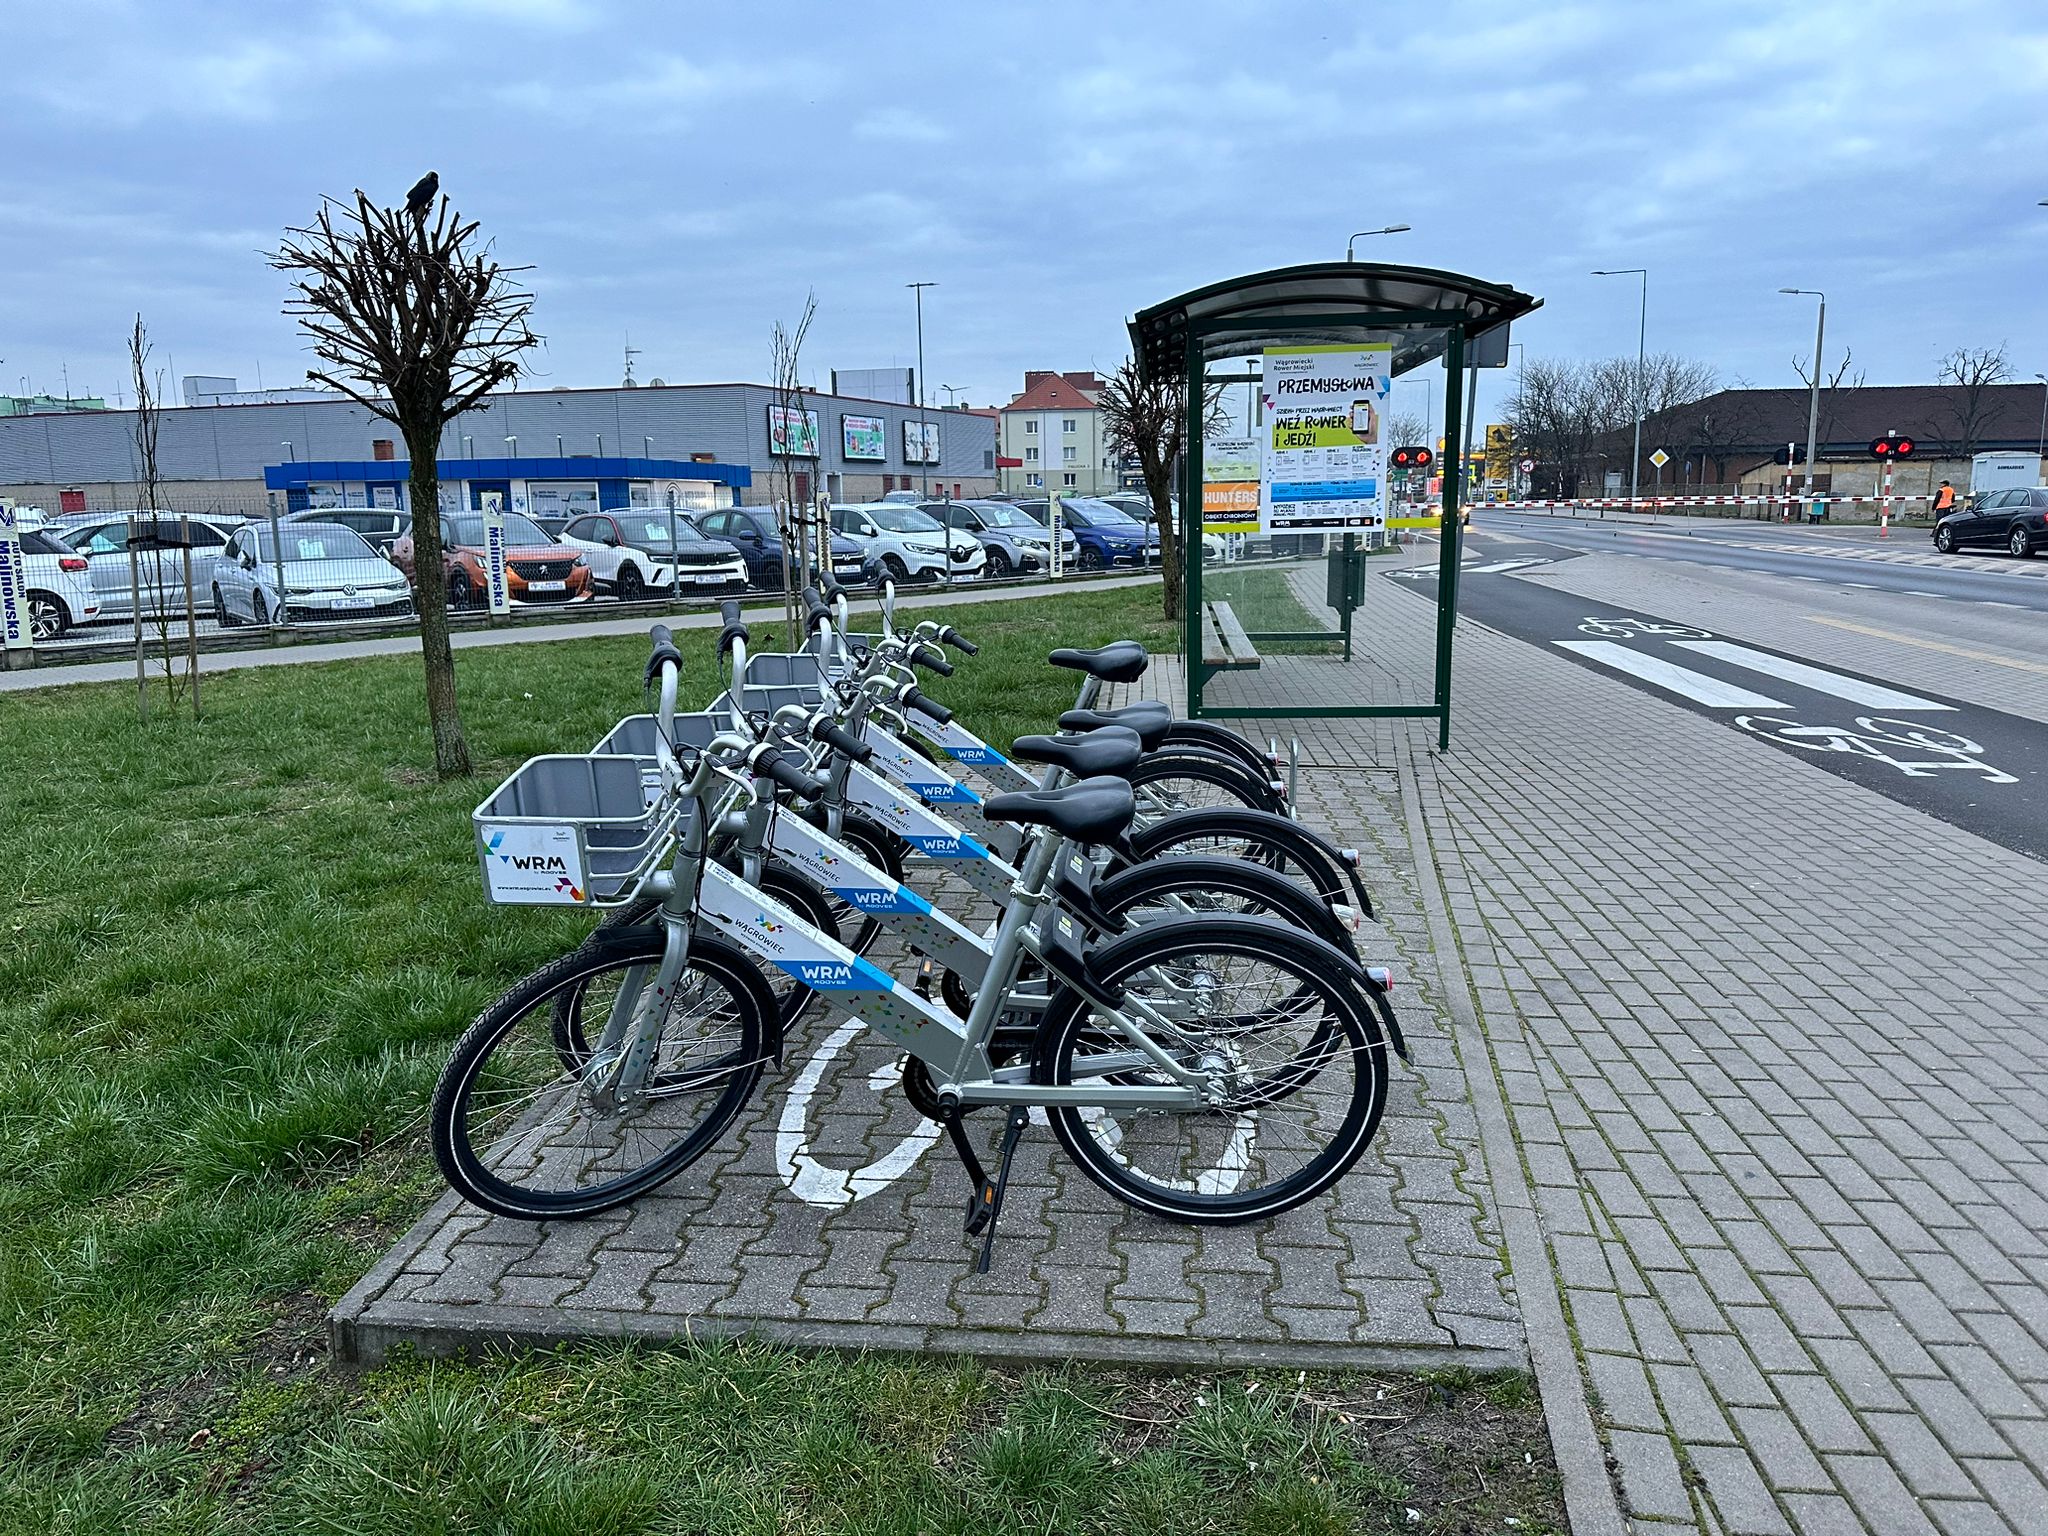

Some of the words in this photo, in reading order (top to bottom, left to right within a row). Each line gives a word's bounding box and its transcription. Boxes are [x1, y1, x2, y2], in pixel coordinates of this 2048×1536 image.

[1275, 357, 1314, 366] Wągrowiecki
[1294, 363, 1314, 371] Miejski
[1278, 376, 1375, 394] PRZEMYSŁOWA
[1276, 414, 1301, 430] WEŹ
[1283, 431, 1316, 447] JEDŹ!
[1204, 491, 1257, 503] HUNTERS
[11, 541, 21, 566] AUTO
[16, 568, 25, 598] SALON
[488, 526, 503, 607] Malinowska
[0, 540, 20, 640] Malinowska
[957, 750, 985, 759] WRM
[882, 756, 913, 779] WĄGROWIEC
[922, 786, 954, 796] WRM
[875, 805, 911, 831] WĄGROWIEC
[923, 840, 960, 850] WRM
[512, 856, 566, 870] WRM
[798, 853, 841, 882] WĄGROWIEC
[855, 892, 897, 904] WRM
[735, 918, 785, 954] WĄGROWIEC
[801, 966, 852, 979] WRM
